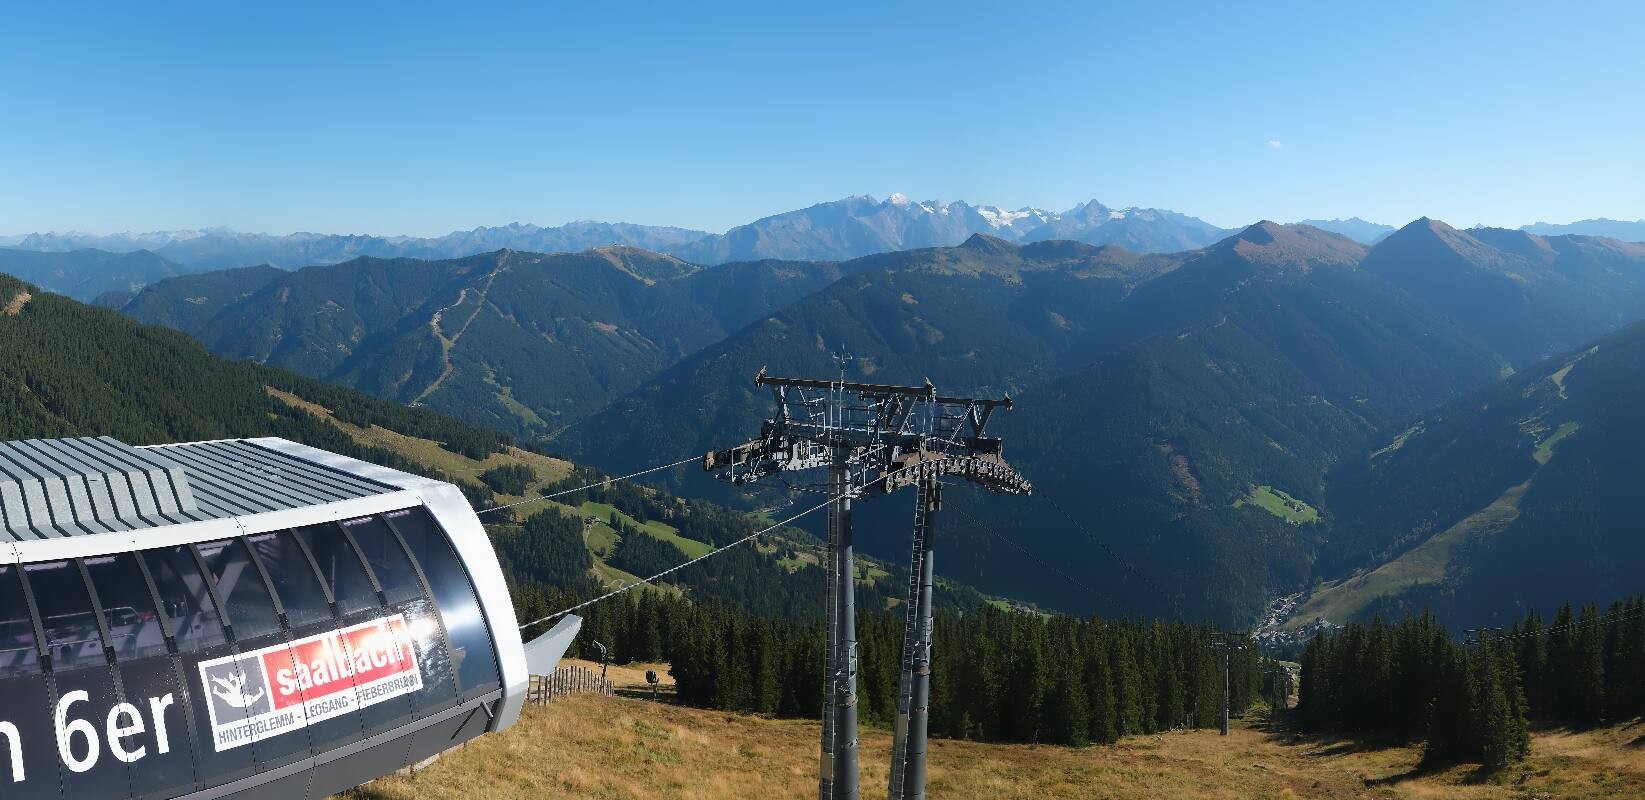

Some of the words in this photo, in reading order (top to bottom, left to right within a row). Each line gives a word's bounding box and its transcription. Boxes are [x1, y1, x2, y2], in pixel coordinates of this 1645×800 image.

[275, 620, 411, 696] saalbach
[54, 689, 174, 773] 6er
[218, 713, 294, 745] HINTERGLEMM
